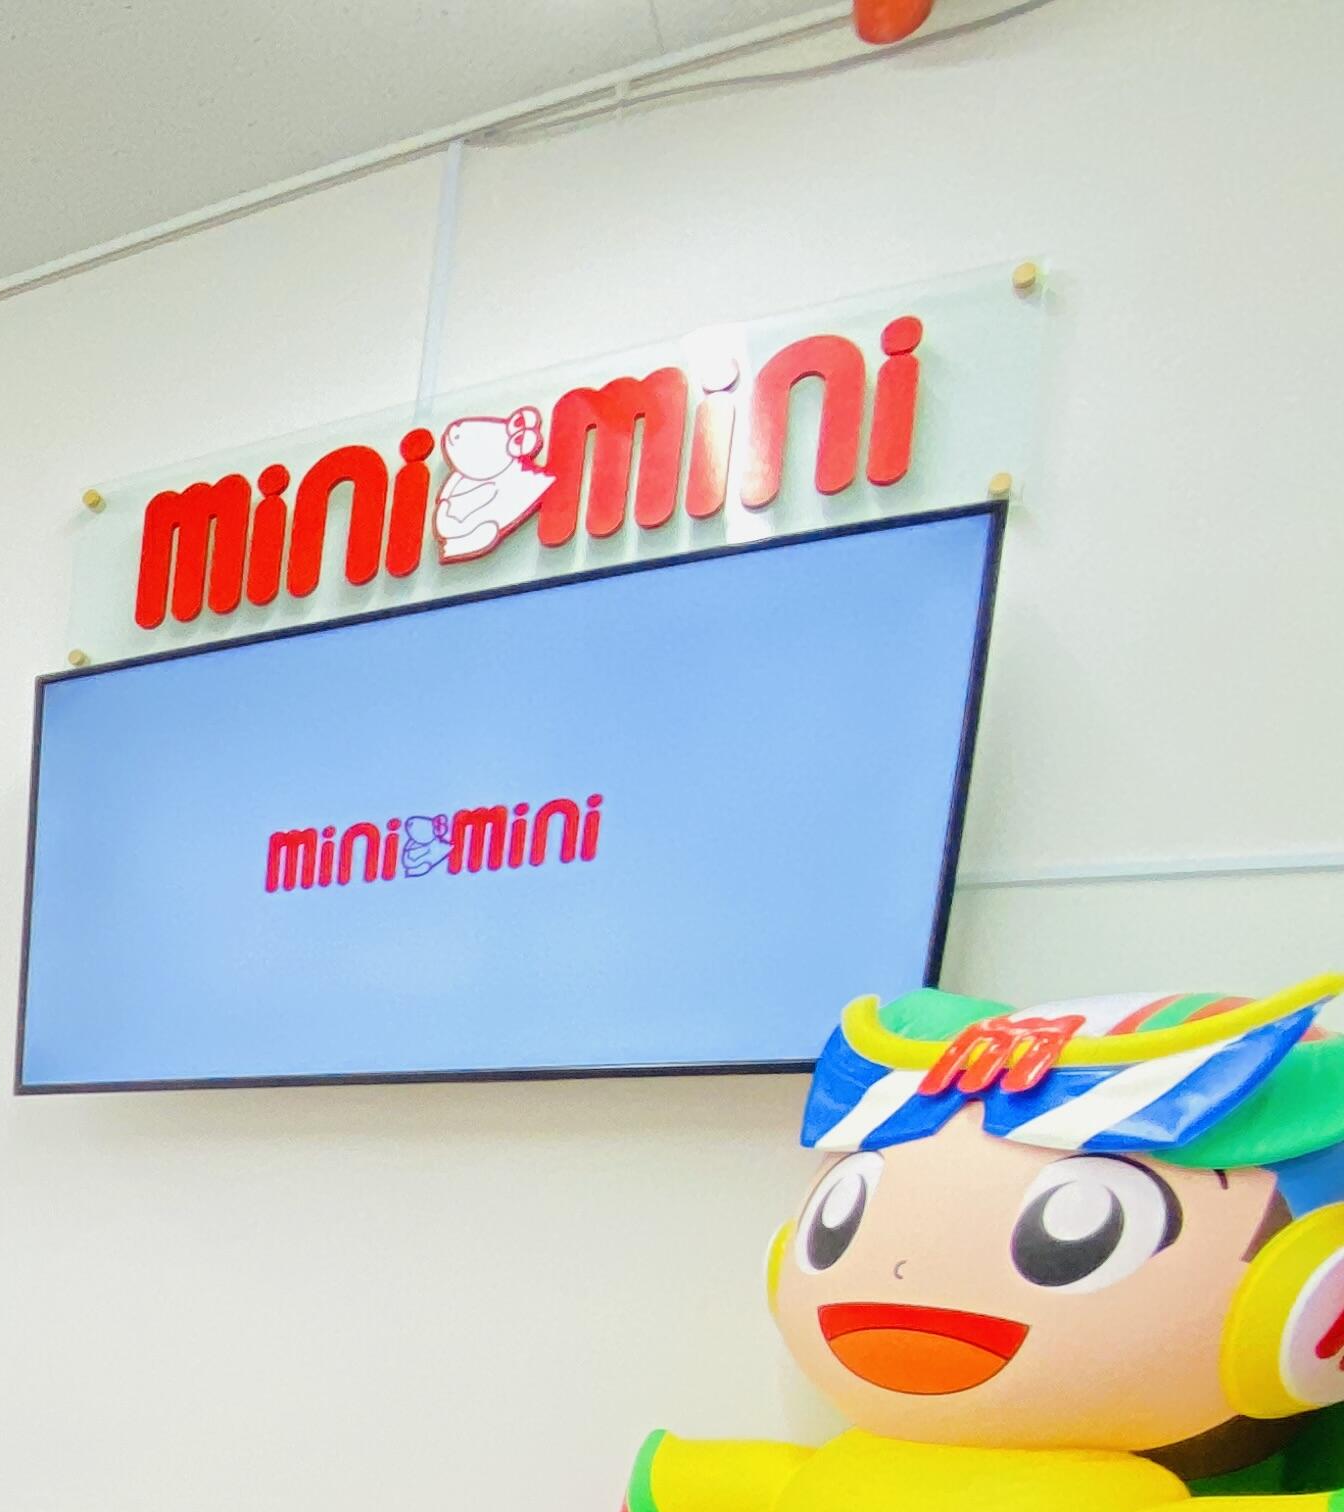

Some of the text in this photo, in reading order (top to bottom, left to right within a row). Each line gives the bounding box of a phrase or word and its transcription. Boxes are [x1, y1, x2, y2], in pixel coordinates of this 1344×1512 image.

[135, 315, 925, 630] mini mini
[265, 793, 604, 893] mini mini
